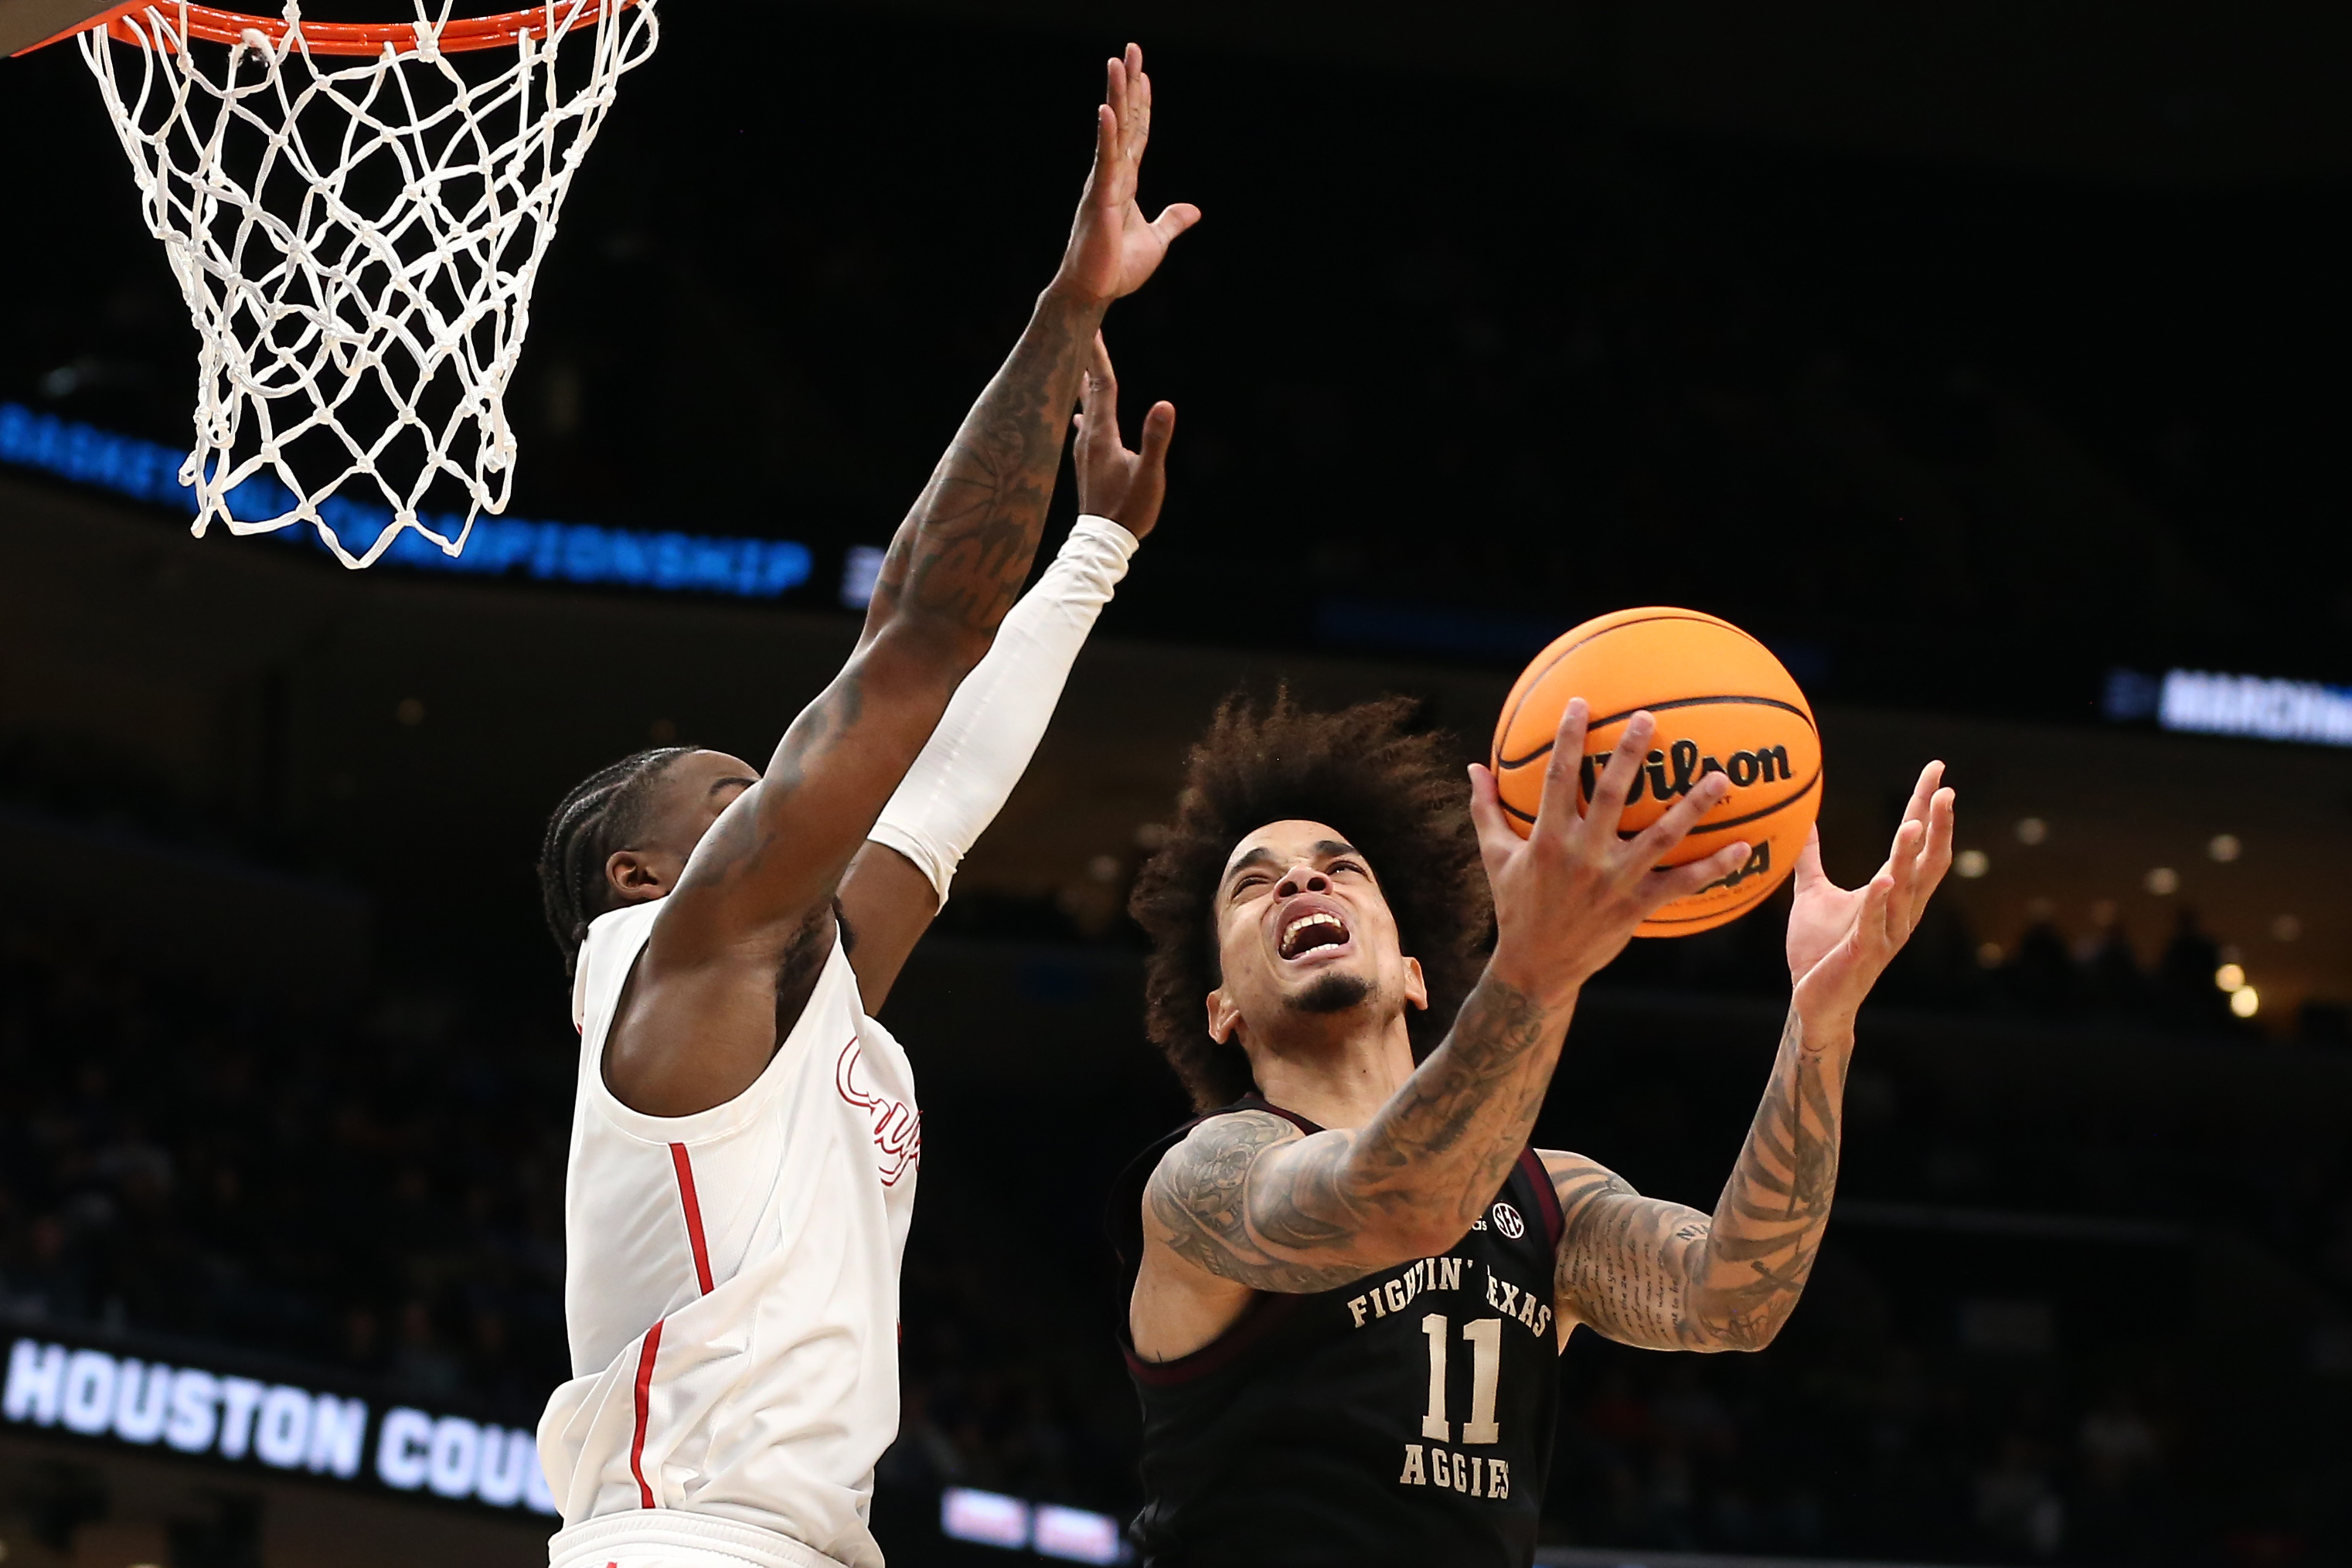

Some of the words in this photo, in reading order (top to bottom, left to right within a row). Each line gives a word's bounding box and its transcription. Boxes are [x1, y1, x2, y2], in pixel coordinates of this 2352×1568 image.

[1493, 1204, 1524, 1238] SEC
[1486, 1264, 1552, 1338] EXAS
[2, 1339, 369, 1478] HOUSTON
[1421, 1313, 1502, 1444] 11
[1400, 1444, 1510, 1499] AGGIES
